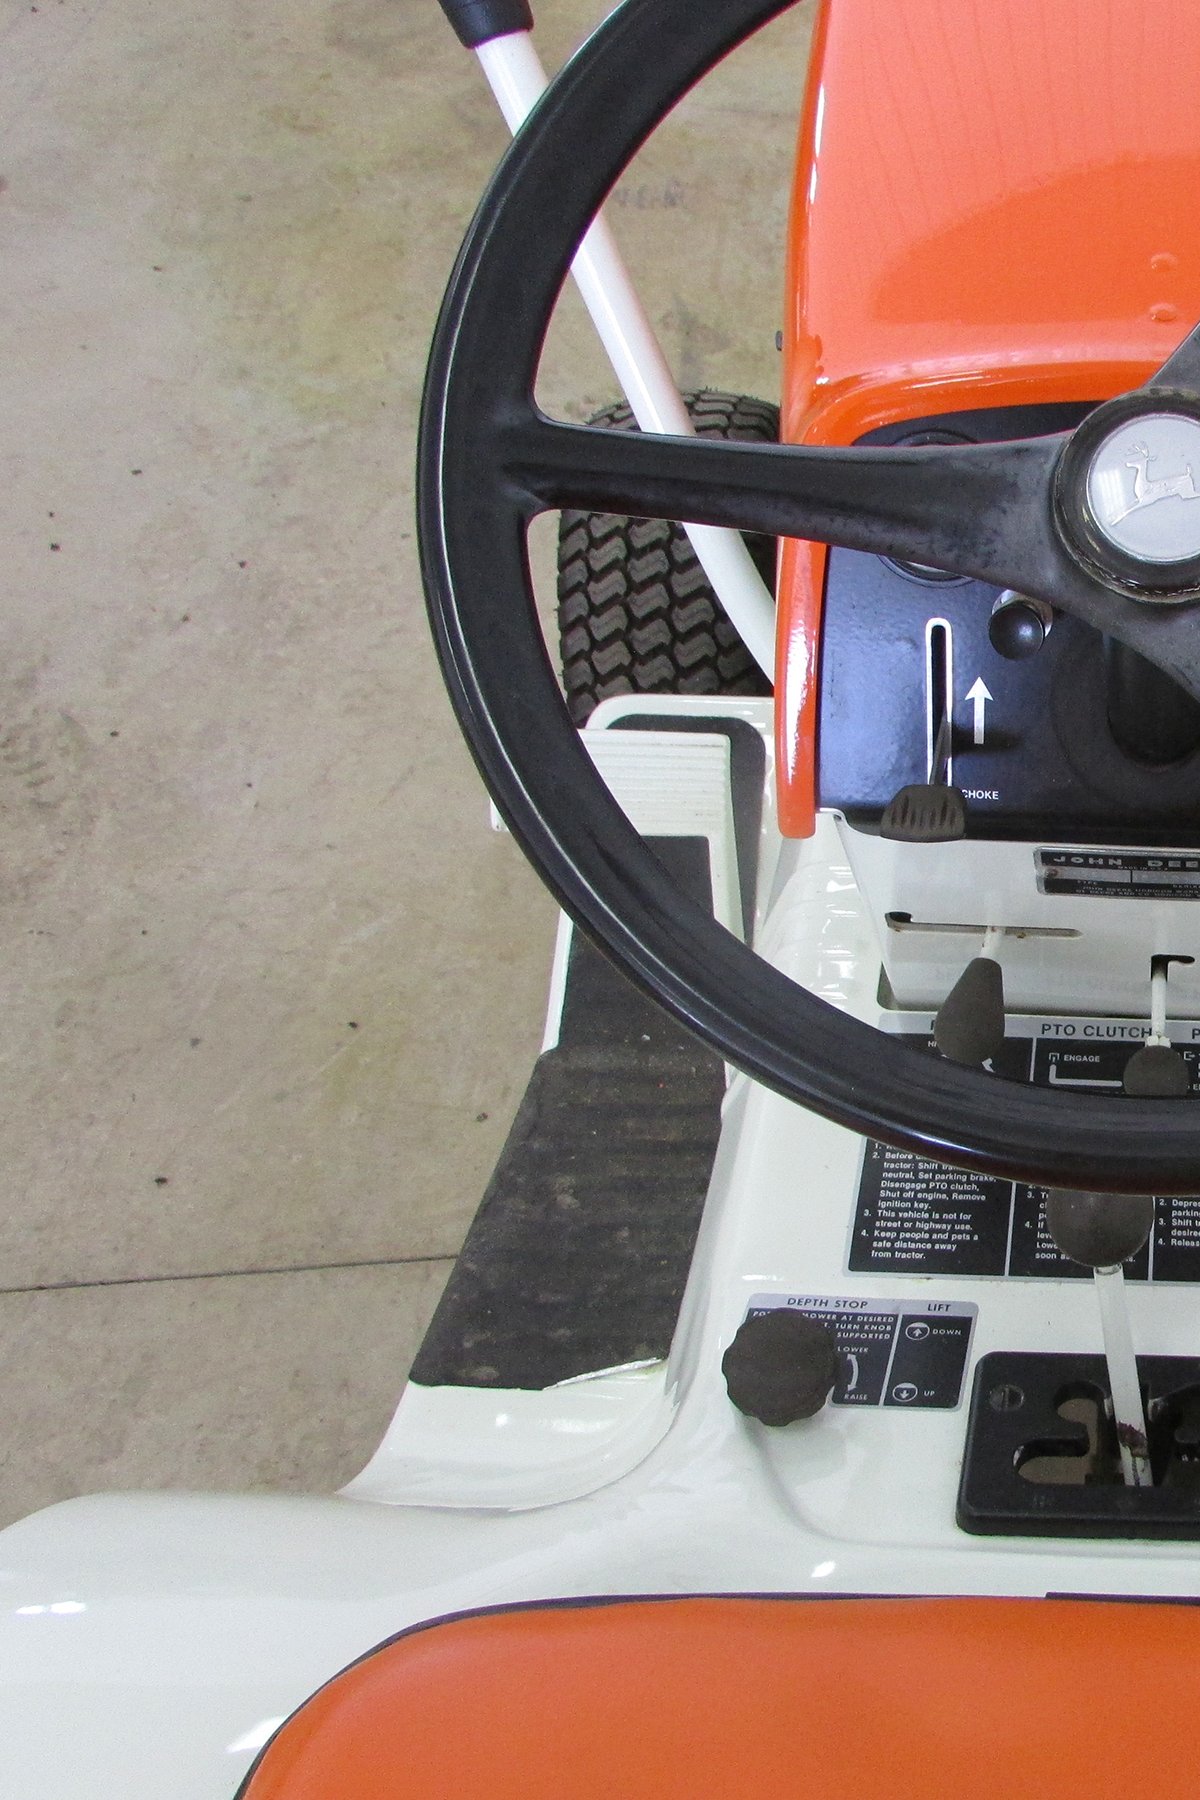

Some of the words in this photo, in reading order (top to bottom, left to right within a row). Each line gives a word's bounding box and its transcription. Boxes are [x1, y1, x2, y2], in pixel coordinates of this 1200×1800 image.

[1053, 856, 1122, 866] JOHN
[1041, 1023, 1076, 1036] PTO
[1083, 1025, 1152, 1038] CLUTCH
[1063, 1054, 1100, 1063] ENGAGE
[885, 1152, 913, 1160] Before
[918, 1162, 938, 1170] Shift
[934, 1173, 967, 1182] parking
[880, 1180, 927, 1190] Disengage
[929, 1182, 948, 1190] PTO
[879, 1189, 900, 1198] Shut
[902, 1190, 915, 1198] off
[951, 1192, 986, 1201] Remove
[1027, 1191, 1035, 1199] 3.
[913, 1201, 932, 1210] key.
[1159, 1198, 1167, 1206] 2.
[863, 1209, 872, 1217] 3.
[877, 1209, 896, 1218] This
[898, 1210, 930, 1219] vehicle
[931, 1211, 940, 1219] is
[942, 1212, 957, 1220] not
[959, 1212, 972, 1220] for
[875, 1220, 901, 1228] street
[903, 1221, 913, 1229] or
[915, 1221, 952, 1231] highway
[954, 1223, 973, 1231] use.
[1024, 1221, 1033, 1229] 4.
[1158, 1218, 1166, 1226] 3.
[1171, 1219, 1192, 1227] Shift
[860, 1229, 869, 1237] 4.
[873, 1229, 897, 1239] Keep
[899, 1230, 930, 1241] people
[931, 1232, 949, 1240] and
[951, 1233, 971, 1242] pets
[872, 1240, 892, 1248] safe
[894, 1241, 932, 1249] distance
[934, 1242, 957, 1252] away
[1157, 1238, 1166, 1246] 4.
[871, 1250, 892, 1258] from
[894, 1251, 926, 1259] tractor.
[1035, 1252, 1057, 1260] soon
[787, 1297, 829, 1307] DEPTH
[834, 1299, 868, 1309] STOP
[927, 1303, 951, 1312] LIFT
[857, 1315, 894, 1323] DESIRED
[837, 1331, 891, 1340] SUPPORTED
[844, 1393, 868, 1401] RAISE
